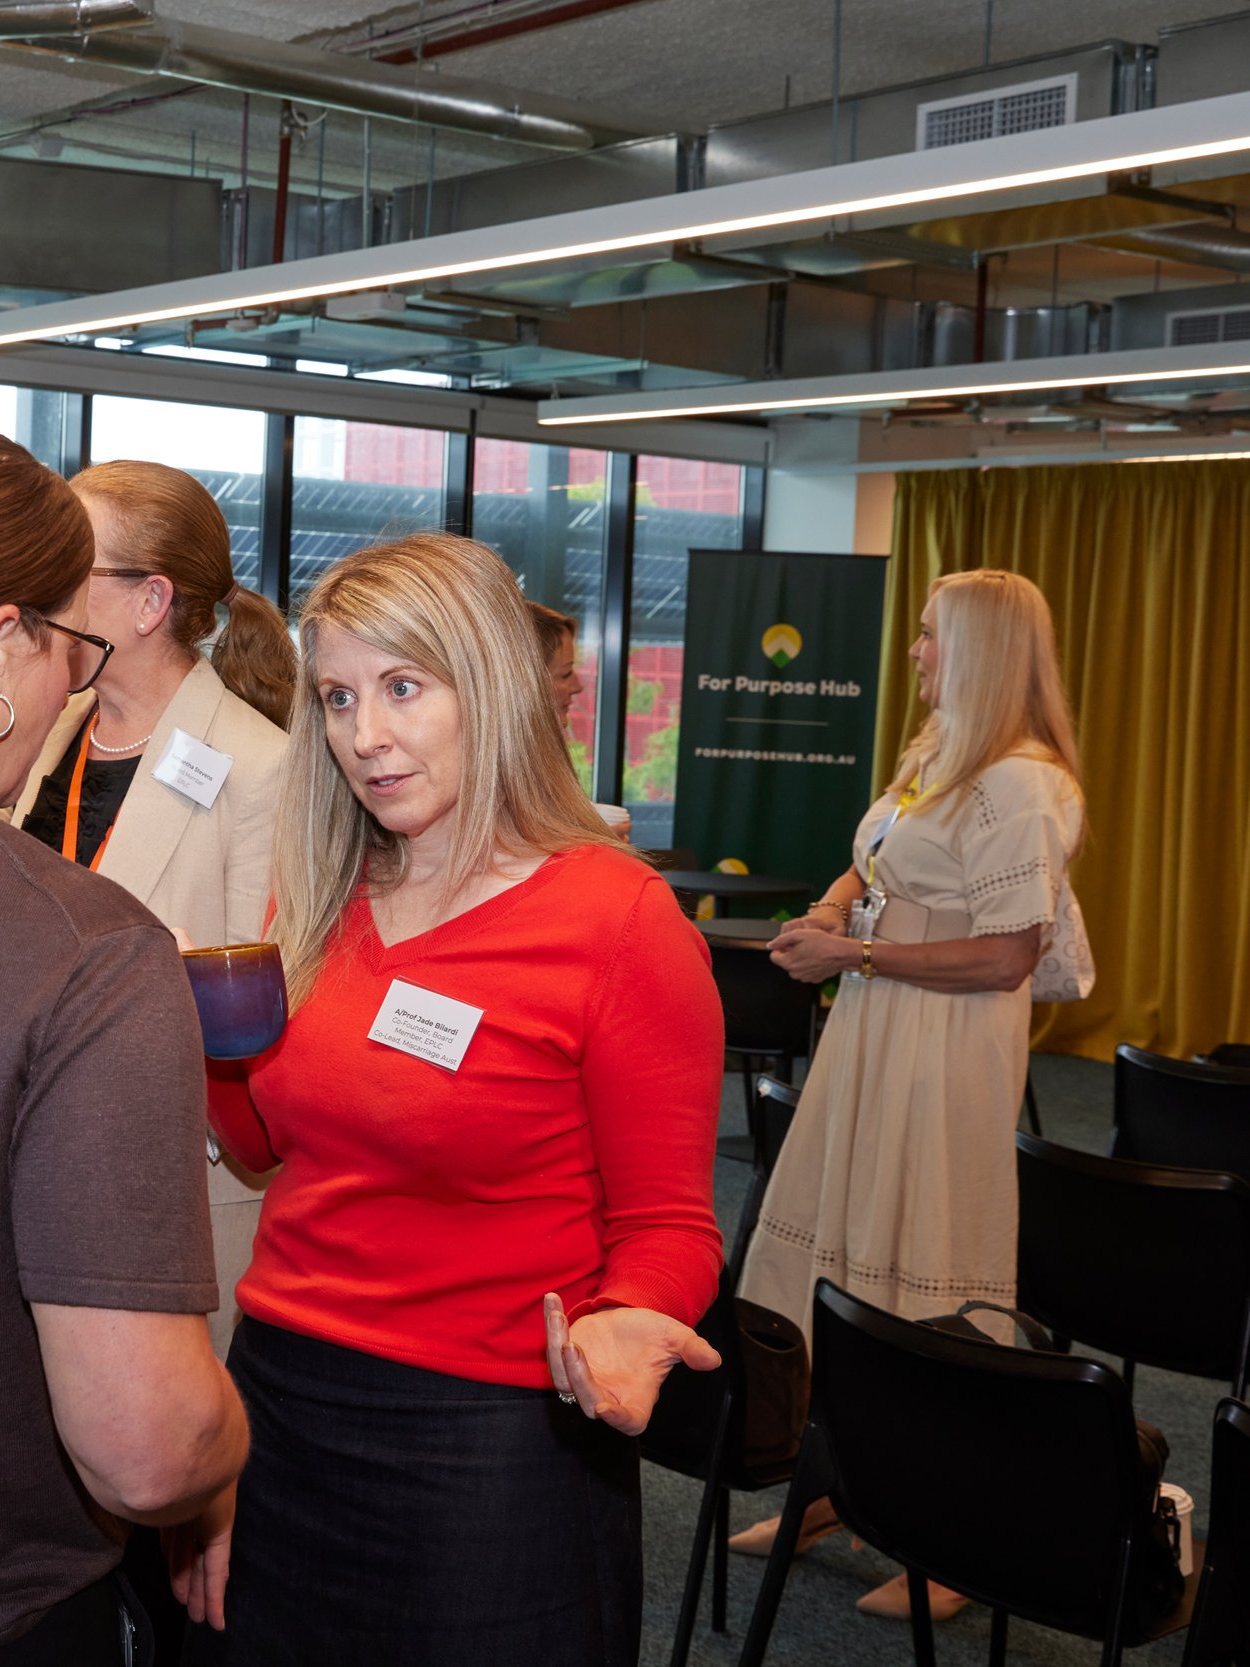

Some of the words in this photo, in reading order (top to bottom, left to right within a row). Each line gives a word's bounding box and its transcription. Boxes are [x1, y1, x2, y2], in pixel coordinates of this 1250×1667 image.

[698, 674, 731, 690] For
[735, 676, 816, 696] Purpose
[820, 680, 861, 696] Hub
[694, 747, 856, 765] FORPURPOSEHUB.ORG.AU
[391, 1017, 431, 1036] Co-Founder,
[433, 1030, 453, 1044] Board
[394, 1008, 418, 1021] A/Prof
[417, 1016, 434, 1027] Jade
[435, 1022, 459, 1036] Bilardi
[373, 1029, 401, 1045] Co-Lead,
[402, 1040, 440, 1059] Miscarriage
[440, 1054, 457, 1066] Aust
[394, 1027, 422, 1043] Member,
[424, 1038, 444, 1050] EPLC
